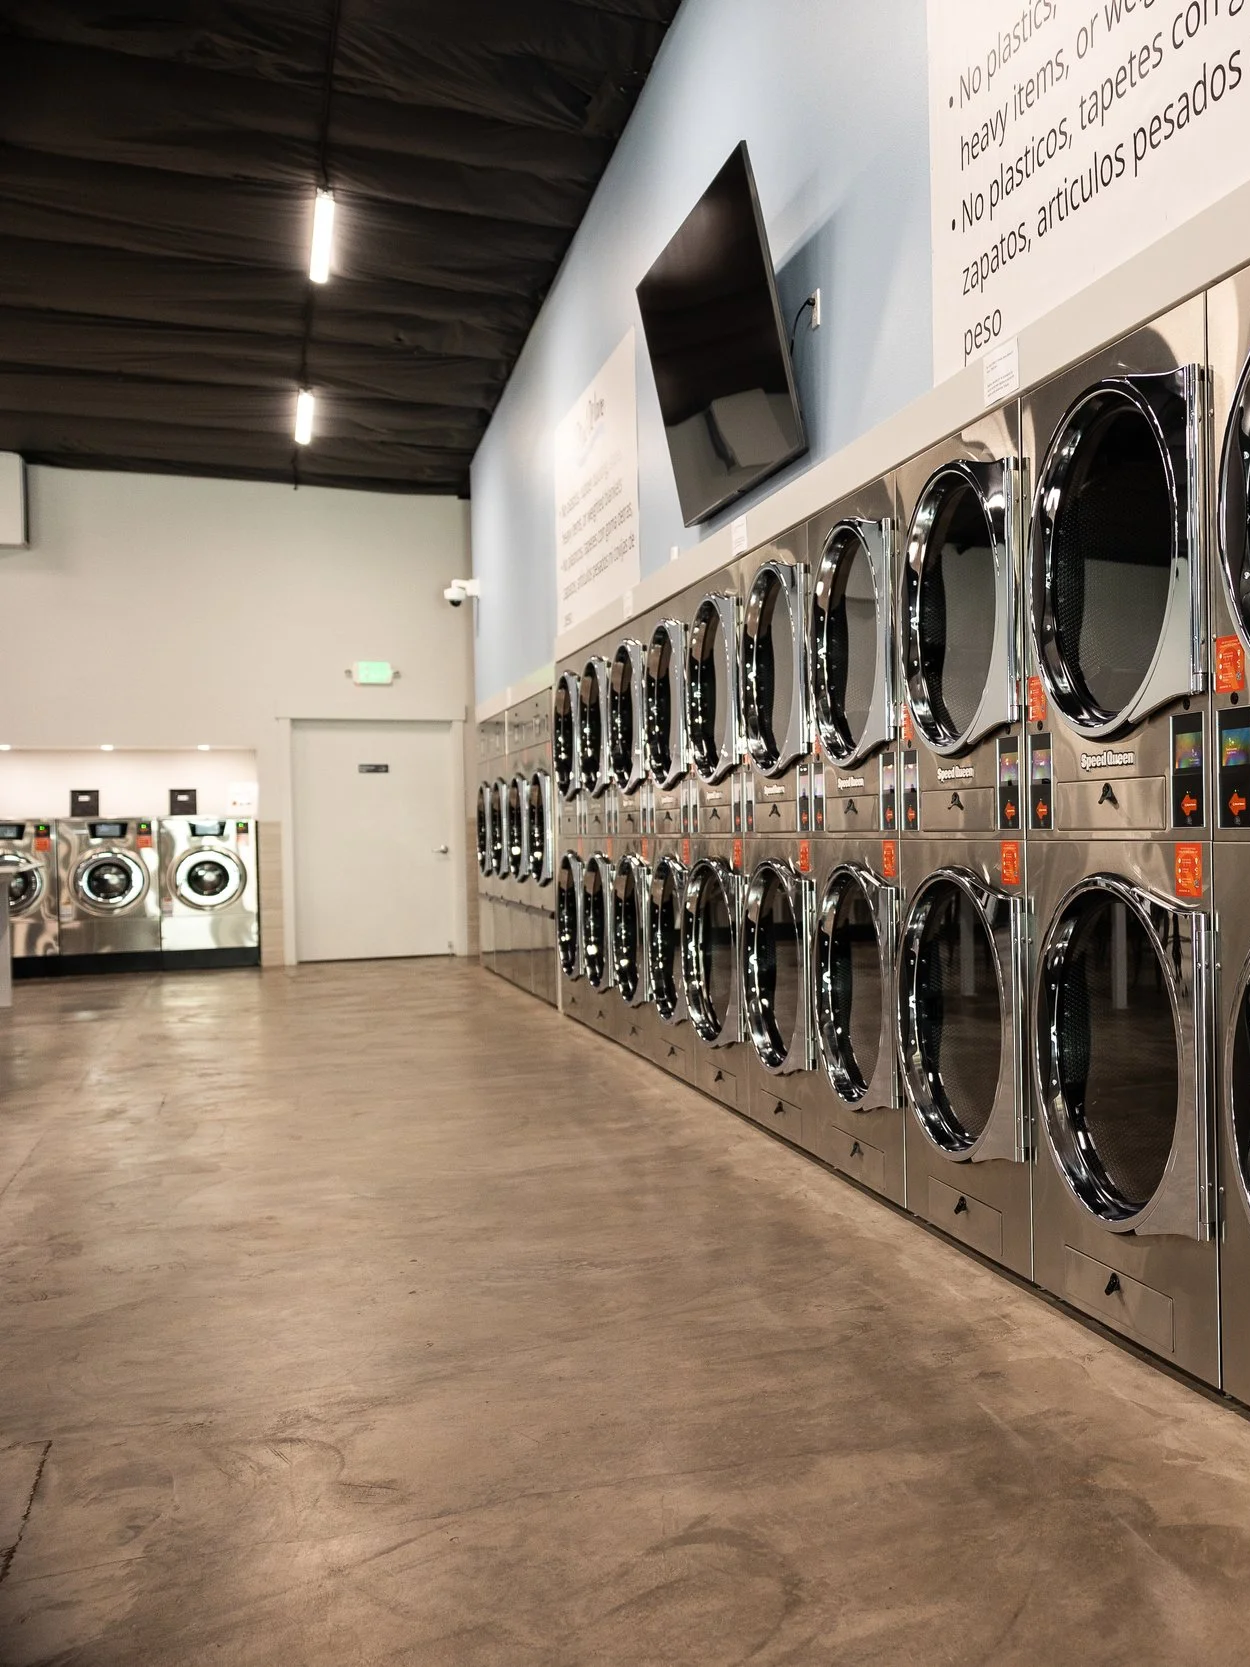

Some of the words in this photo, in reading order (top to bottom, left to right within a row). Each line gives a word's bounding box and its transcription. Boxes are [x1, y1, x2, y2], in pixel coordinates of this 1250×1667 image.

[959, 66, 982, 109] No
[986, 0, 1057, 92] plastics,
[960, 102, 1009, 171] heavy
[1013, 48, 1070, 122] items,
[1076, 13, 1099, 60] or
[962, 192, 984, 234] No
[989, 117, 1074, 222] plasticos,
[1078, 31, 1164, 131] tapetes
[962, 221, 1032, 296] zapatos,
[1037, 143, 1126, 238] articulos
[1132, 49, 1243, 178] pesados
[964, 308, 1003, 368] peso
[1080, 750, 1107, 772] Speed
[1106, 749, 1135, 767] Queen
